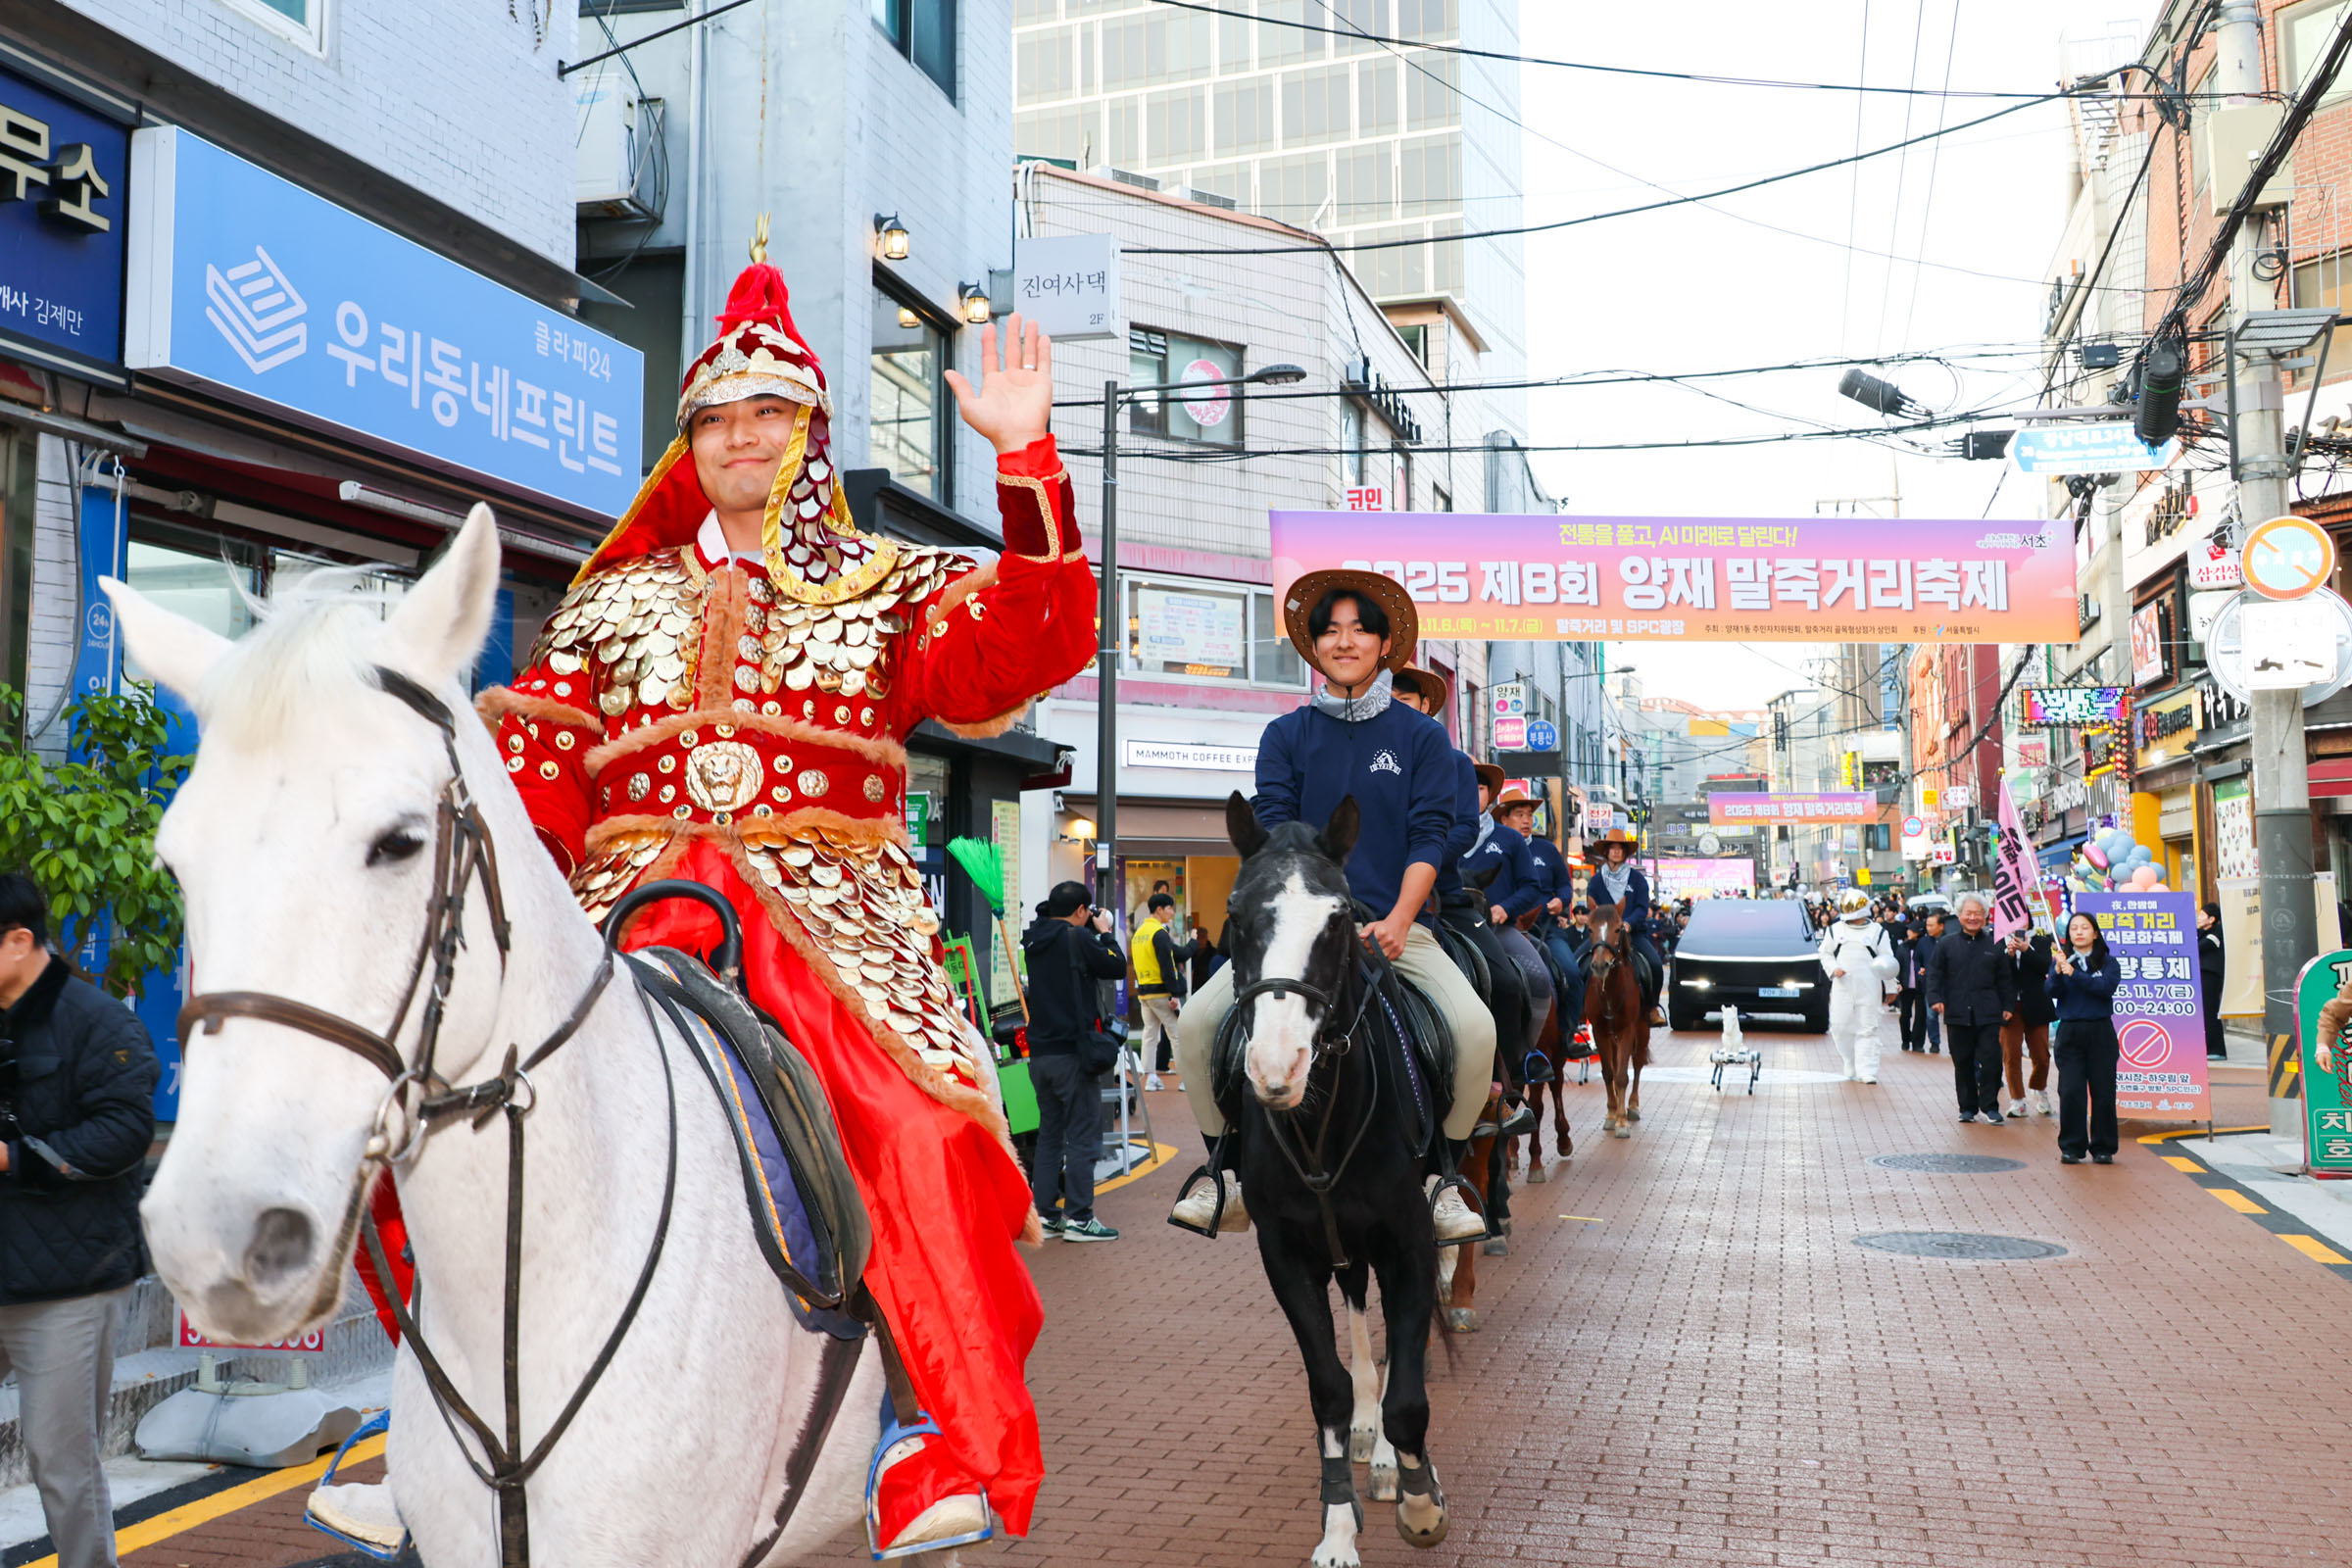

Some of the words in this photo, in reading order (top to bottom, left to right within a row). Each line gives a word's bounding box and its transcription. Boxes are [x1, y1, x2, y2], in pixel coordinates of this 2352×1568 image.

[0, 104, 111, 233] 무소
[1022, 270, 1105, 298] 진여사댁
[34, 297, 83, 336] 김제만
[1089, 314, 1104, 325] 2F
[534, 319, 612, 383] 클라피24
[326, 300, 622, 477] 우리동네프린트
[1348, 488, 1382, 511] 코인
[1559, 524, 1614, 546] 전통을
[1616, 524, 1656, 548] 품고,
[1659, 525, 1679, 545] AI
[1682, 525, 1736, 547] 미래로
[1738, 525, 1798, 548] 달린다!
[2021, 534, 2047, 548] 서초
[1480, 561, 1599, 606] 제8회
[1619, 556, 1716, 610] 양재
[1726, 557, 2008, 611] 말죽거리축제
[1494, 617, 1544, 634] 11.7.(금)
[1556, 618, 1607, 634] 말죽거리
[1610, 619, 1624, 634] 및
[1627, 619, 1686, 636] SPC광장
[1946, 626, 1980, 635] 서울특별시
[1496, 686, 1521, 699] 양재
[1530, 731, 1553, 746] 부동산
[1136, 750, 1189, 760] MAMMOTH
[1193, 752, 1232, 763] COFFEE
[1725, 804, 1753, 816] 2025
[2096, 912, 2176, 929] 말죽거리
[2101, 930, 2183, 944] 식문화축제
[2116, 956, 2191, 980] 량통제
[2114, 1002, 2194, 1013] 00~24:00
[2321, 1111, 2352, 1134] 치
[2323, 1138, 2352, 1159] 호
